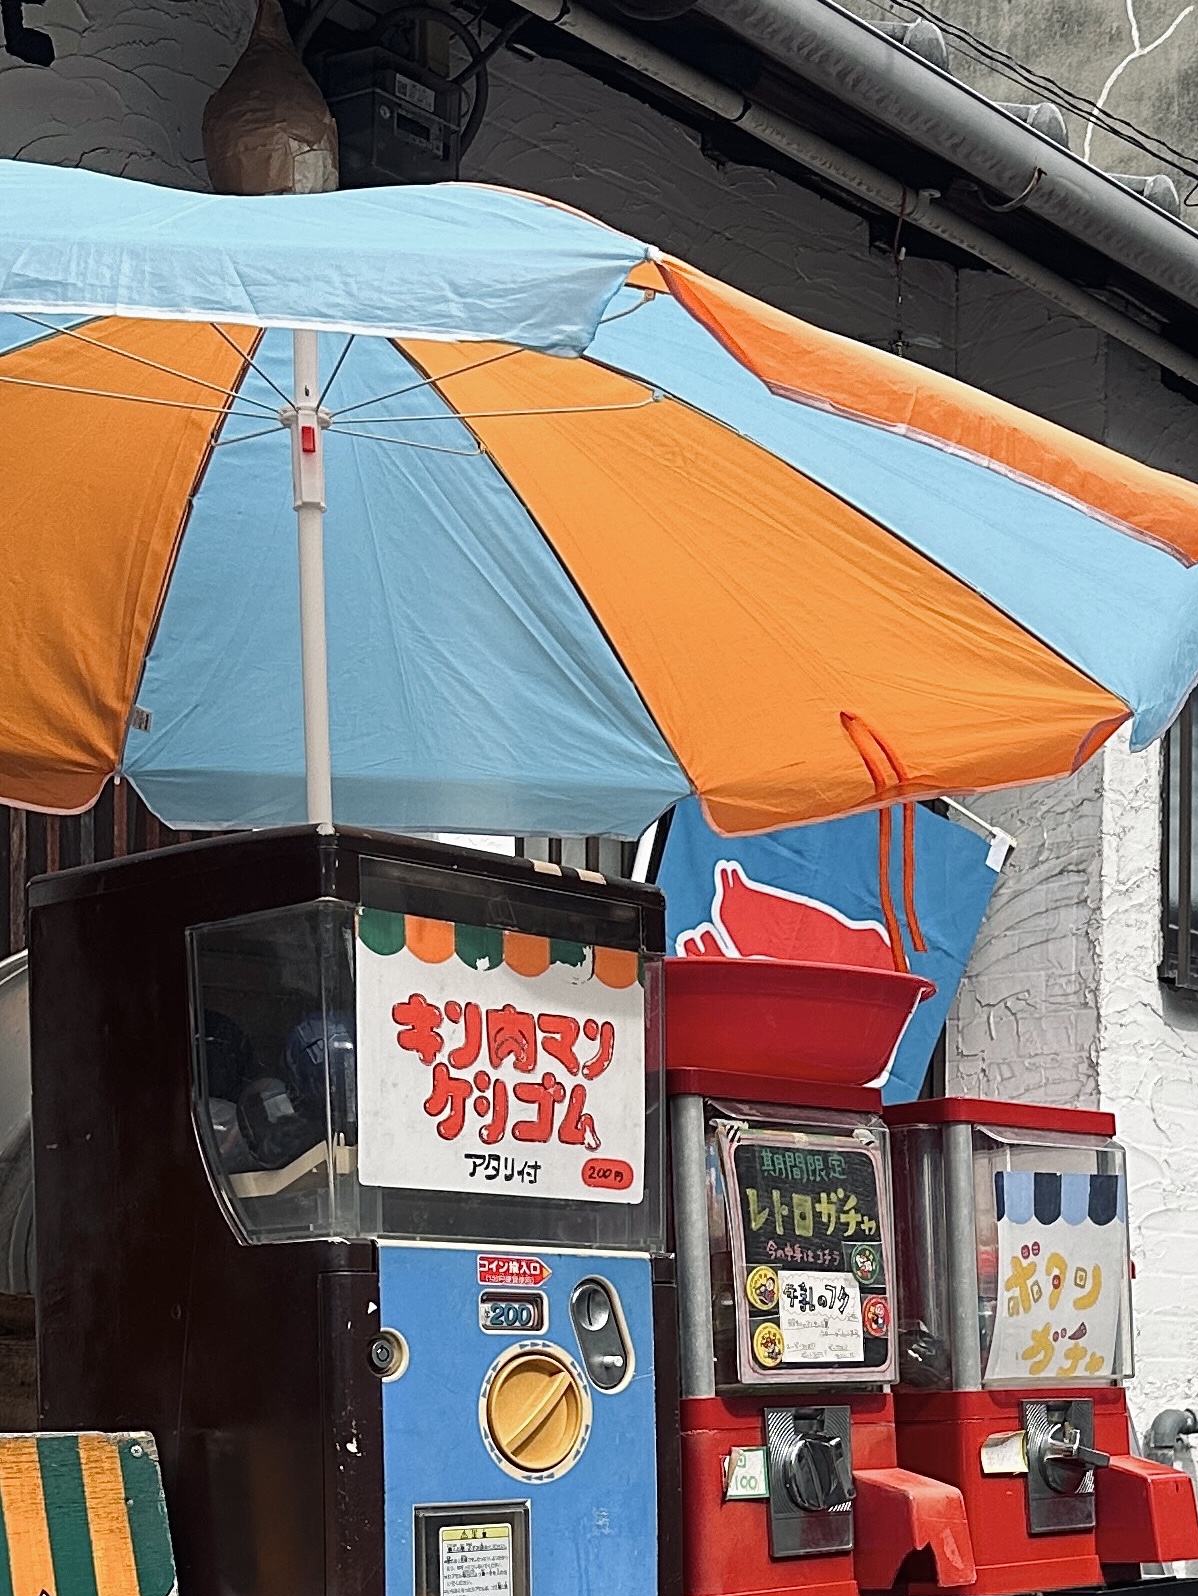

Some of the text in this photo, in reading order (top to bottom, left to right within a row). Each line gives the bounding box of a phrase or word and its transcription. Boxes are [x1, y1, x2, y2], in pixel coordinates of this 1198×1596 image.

[392, 993, 615, 1080] キン肉マン
[464, 1153, 542, 1184] アタリ付
[587, 1165, 625, 1183] 200円
[761, 1149, 848, 1182] 期間限定
[746, 1187, 877, 1238] レトロガチャ
[480, 1260, 540, 1274] コイン投入口
[1004, 1241, 1103, 1318] ボタン
[1021, 1321, 1105, 1378] ガチャ
